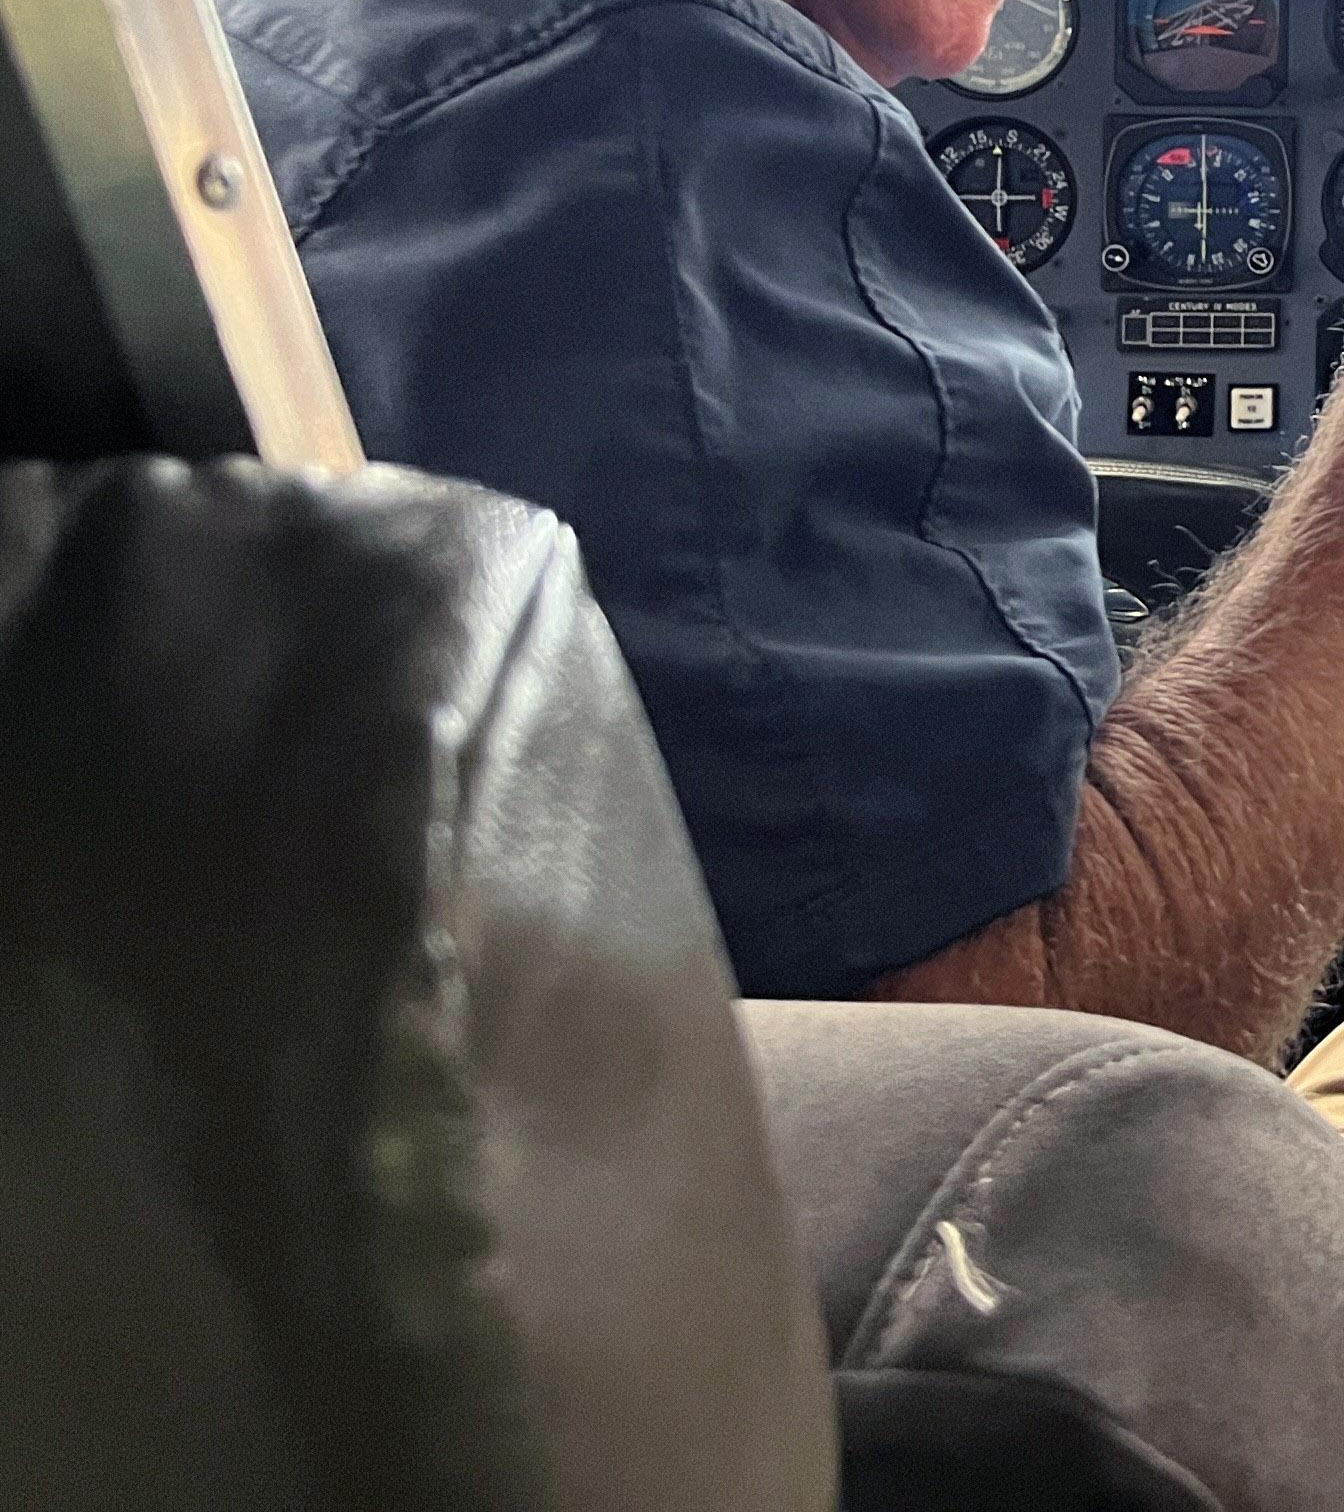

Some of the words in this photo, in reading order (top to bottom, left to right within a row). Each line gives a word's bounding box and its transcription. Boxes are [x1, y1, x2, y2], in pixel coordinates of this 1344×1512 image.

[968, 128, 988, 145] 15
[1006, 128, 1018, 144] S
[938, 145, 960, 165] 12
[1032, 142, 1052, 162] 21
[1052, 170, 1070, 190] 24
[1052, 204, 1069, 222] W
[1169, 302, 1210, 312] CENTURY
[1226, 302, 1258, 312] MODES
